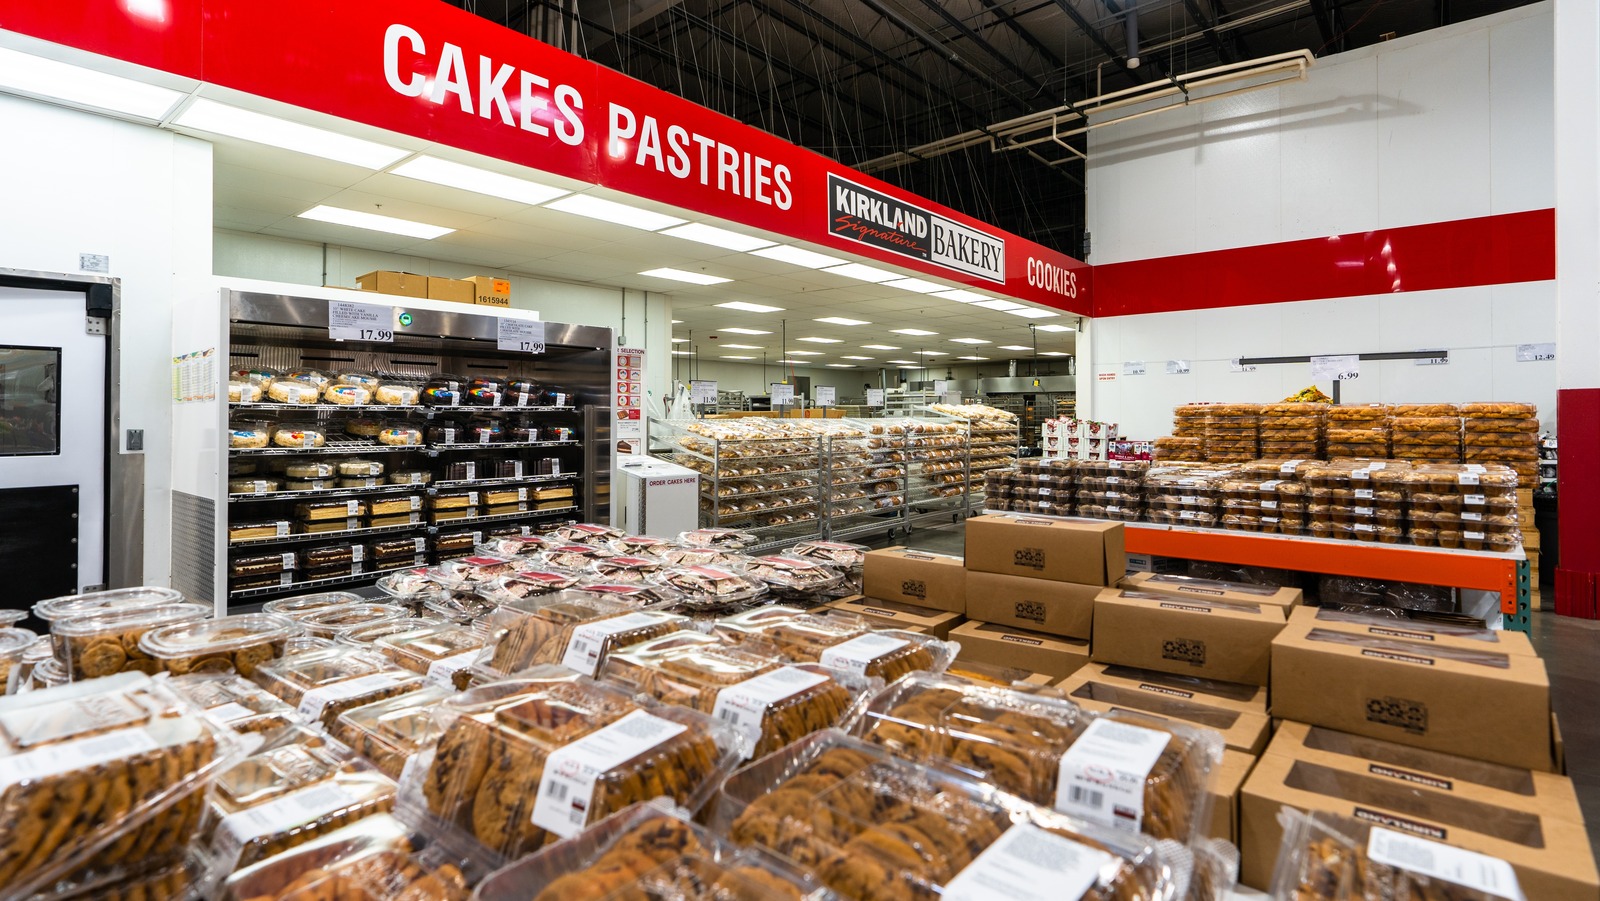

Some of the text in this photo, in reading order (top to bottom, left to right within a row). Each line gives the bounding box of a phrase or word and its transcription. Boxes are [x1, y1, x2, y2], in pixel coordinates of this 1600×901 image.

[383, 23, 793, 211] CAKES PASTRIES
[835, 185, 928, 240] KIRKLAND
[834, 214, 928, 254] Signature
[933, 223, 1002, 274] BAKERY
[1027, 256, 1077, 299] COOKIES
[478, 295, 509, 305] 1615944
[360, 329, 392, 341] 17.99
[520, 341, 544, 351] 17.99
[620, 347, 645, 355] SELECTION
[1338, 372, 1359, 380] 6.99
[703, 396, 717, 404] 11.99
[1003, 635, 1040, 645] KIRKLAND
[1141, 684, 1190, 699] KIRKLAND
[1370, 766, 1449, 790] KIRKLAND
[1355, 810, 1444, 839] KIRKLAND
